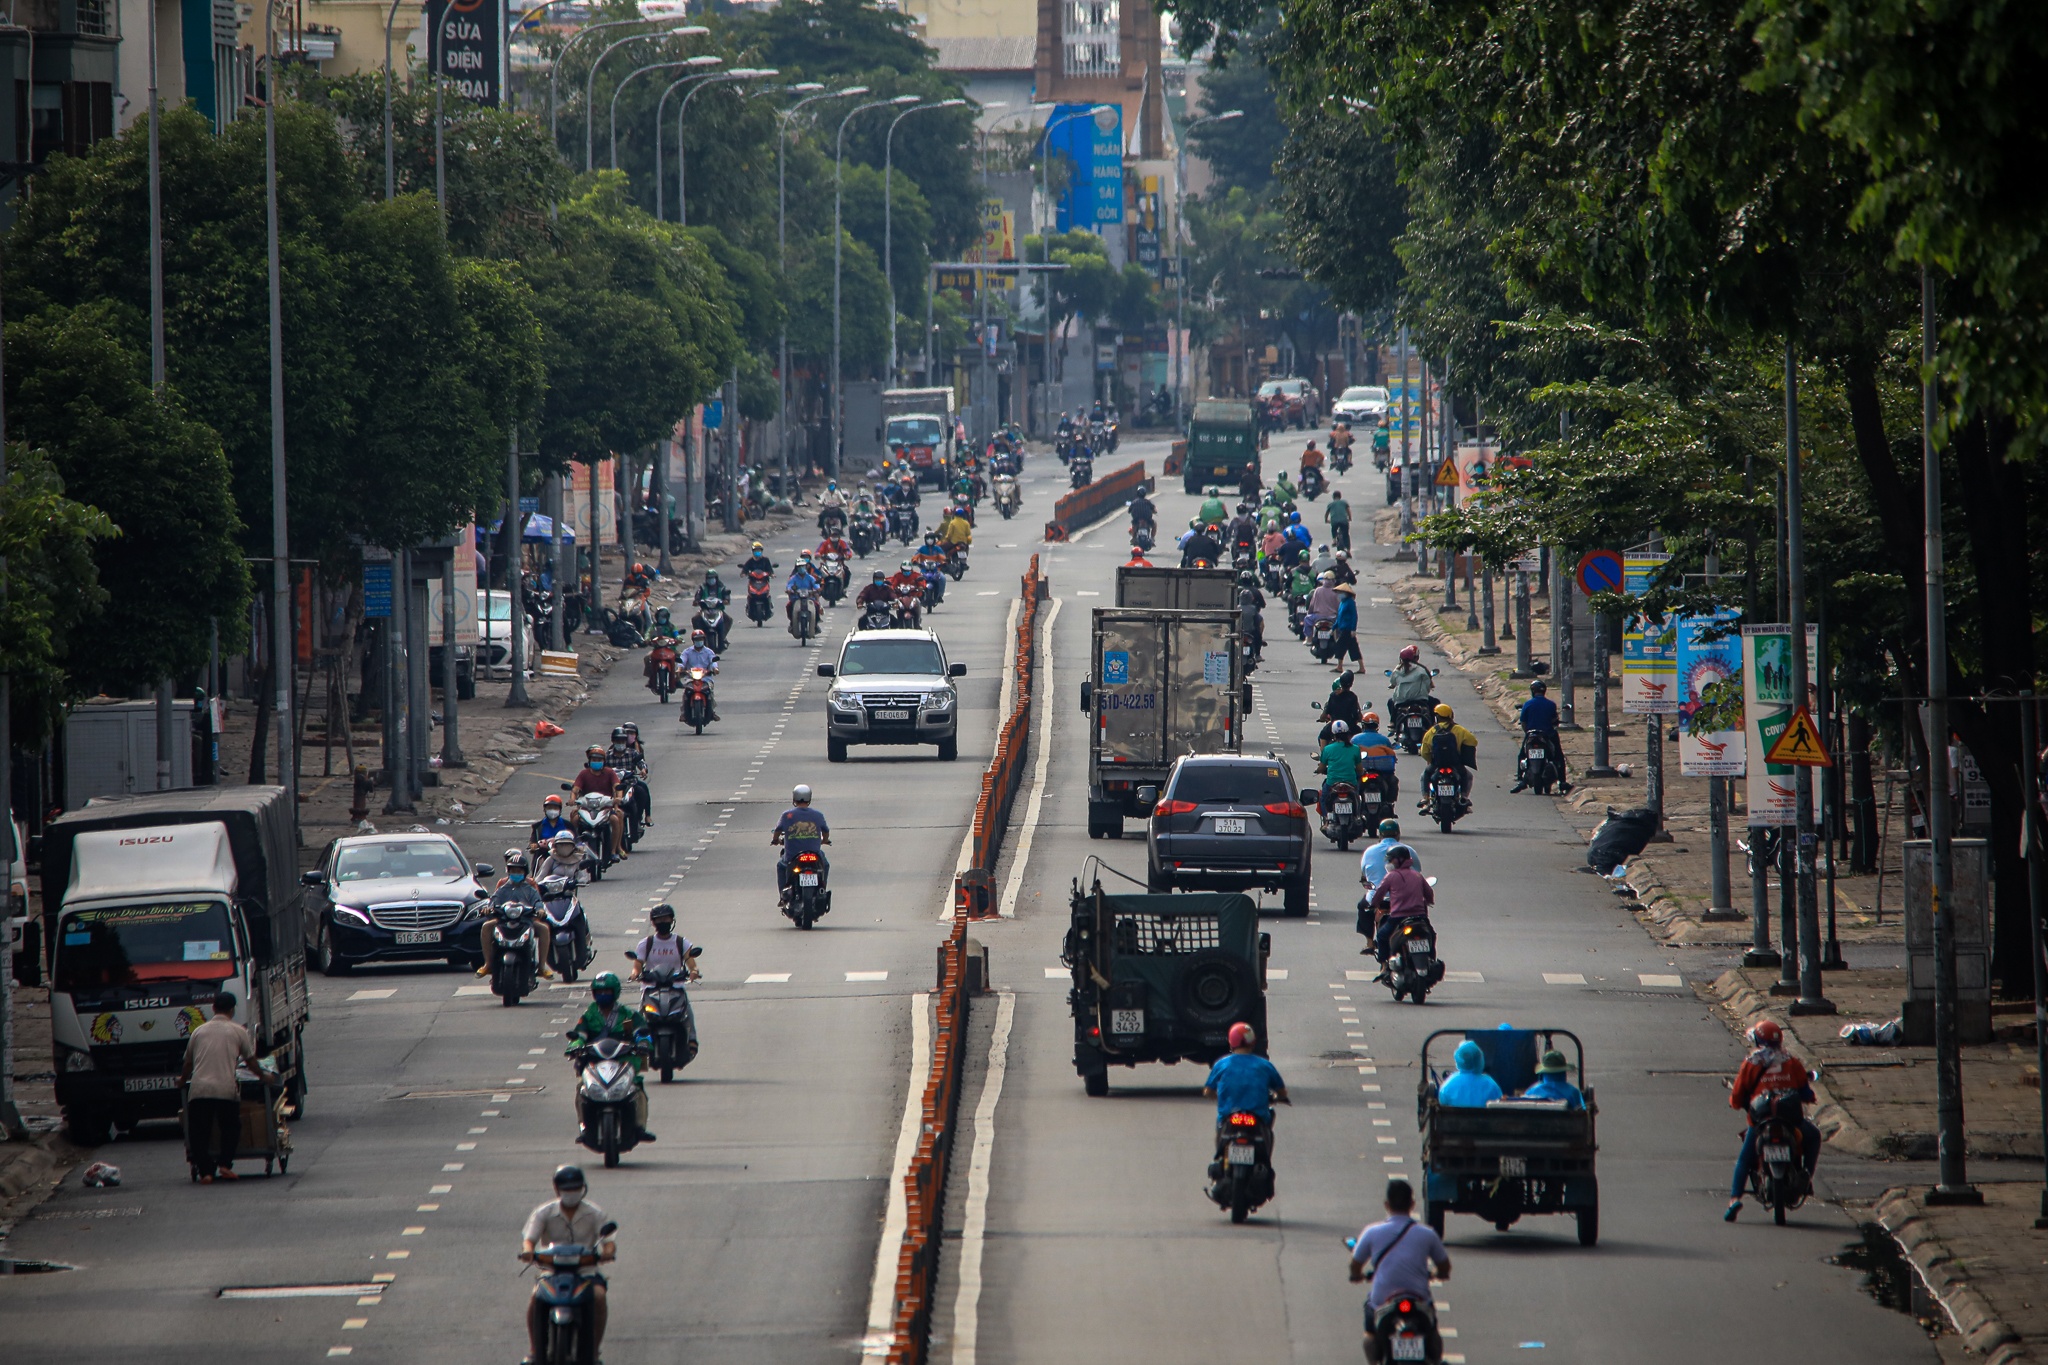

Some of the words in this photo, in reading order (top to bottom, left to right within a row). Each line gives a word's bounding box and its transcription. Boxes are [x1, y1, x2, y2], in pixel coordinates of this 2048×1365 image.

[445, 17, 482, 40] SỬA
[446, 45, 482, 74] ĐIỆN
[441, 80, 489, 102] TOẠI
[1101, 694, 1155, 710] 51D-422.58
[119, 835, 174, 847] ISUZU
[398, 932, 440, 943] 51G-351.94
[124, 997, 170, 1010] ISUZU
[1118, 1011, 1137, 1022] 52S
[1115, 1022, 1140, 1032] 3432
